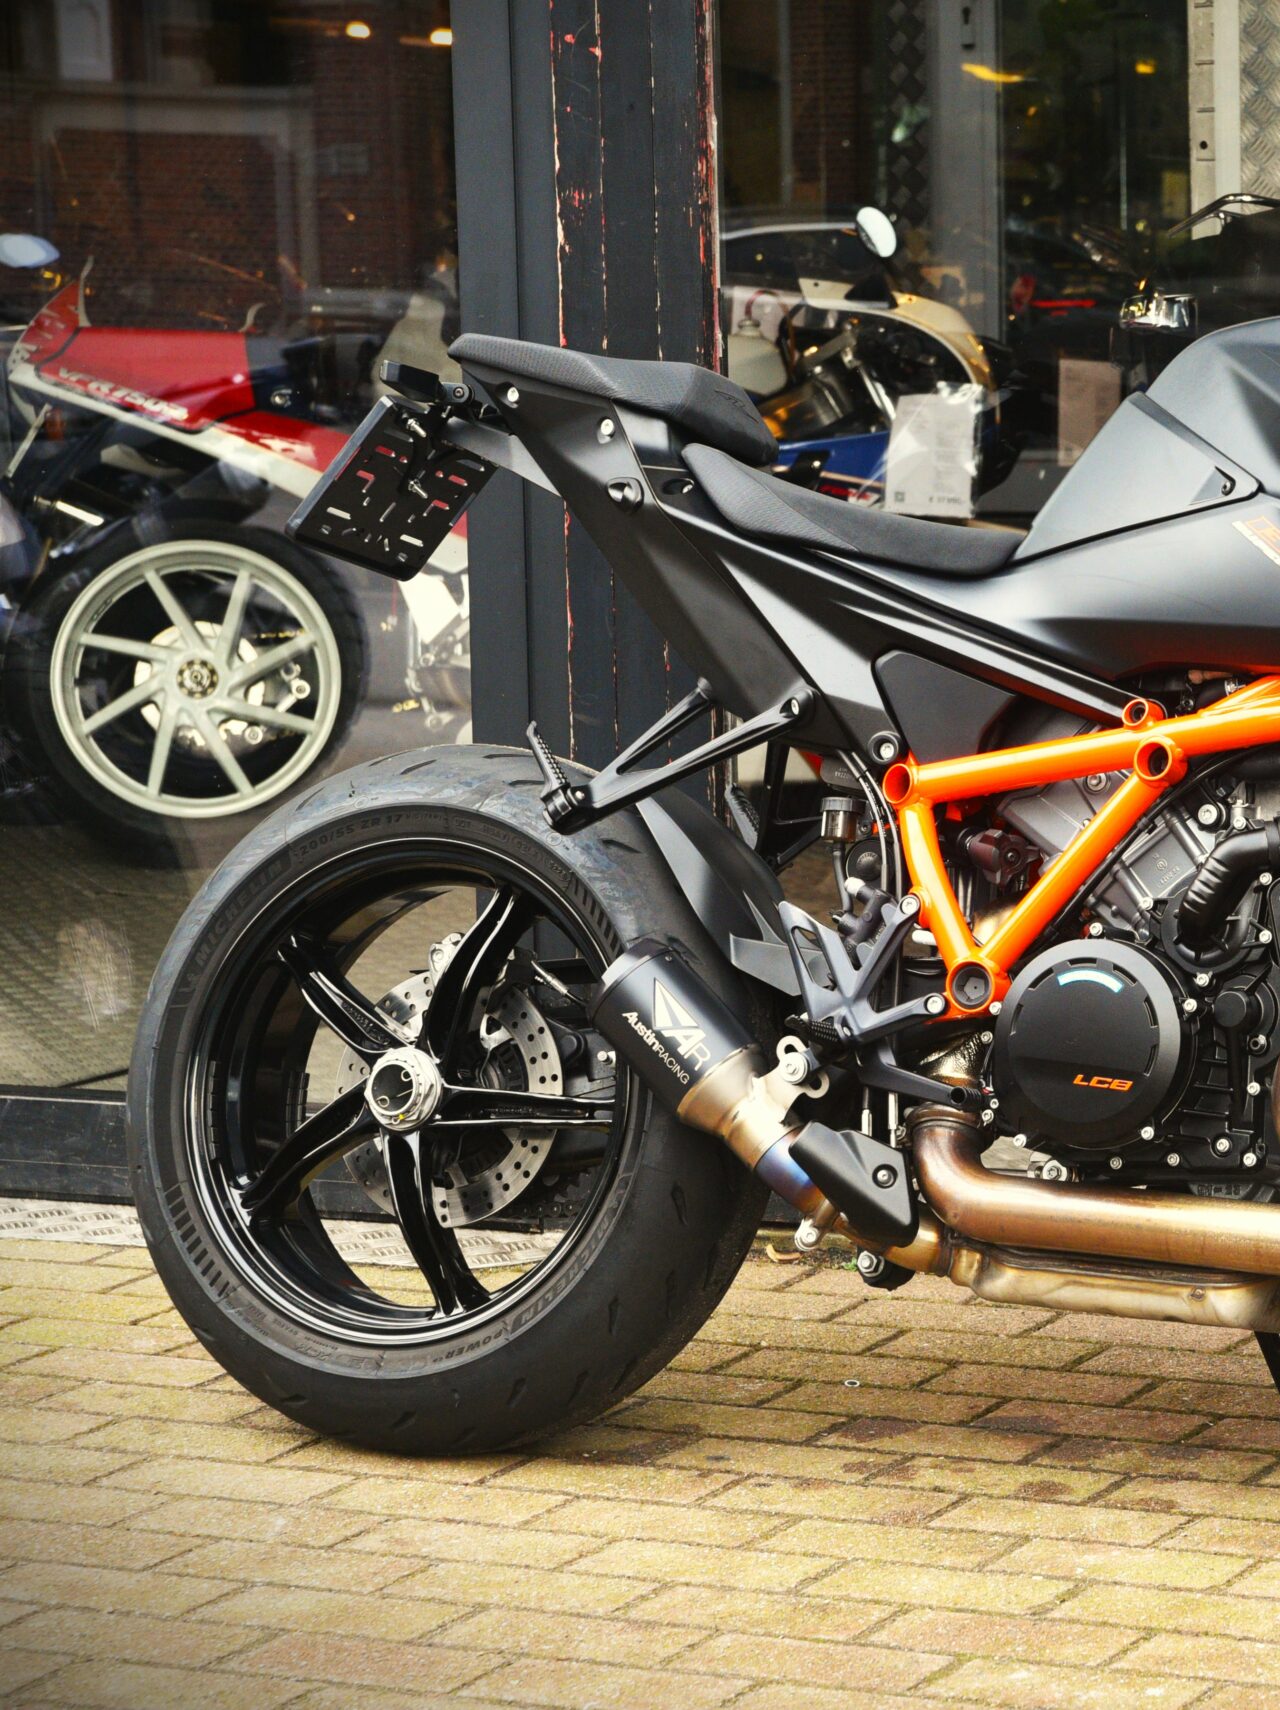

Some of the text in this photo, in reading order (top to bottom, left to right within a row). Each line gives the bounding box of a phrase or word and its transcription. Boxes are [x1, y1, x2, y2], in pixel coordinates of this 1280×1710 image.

[195, 859, 284, 967] MICHELIN
[520, 1219, 609, 1325] MICHELIN
[444, 1331, 504, 1360] POWER
